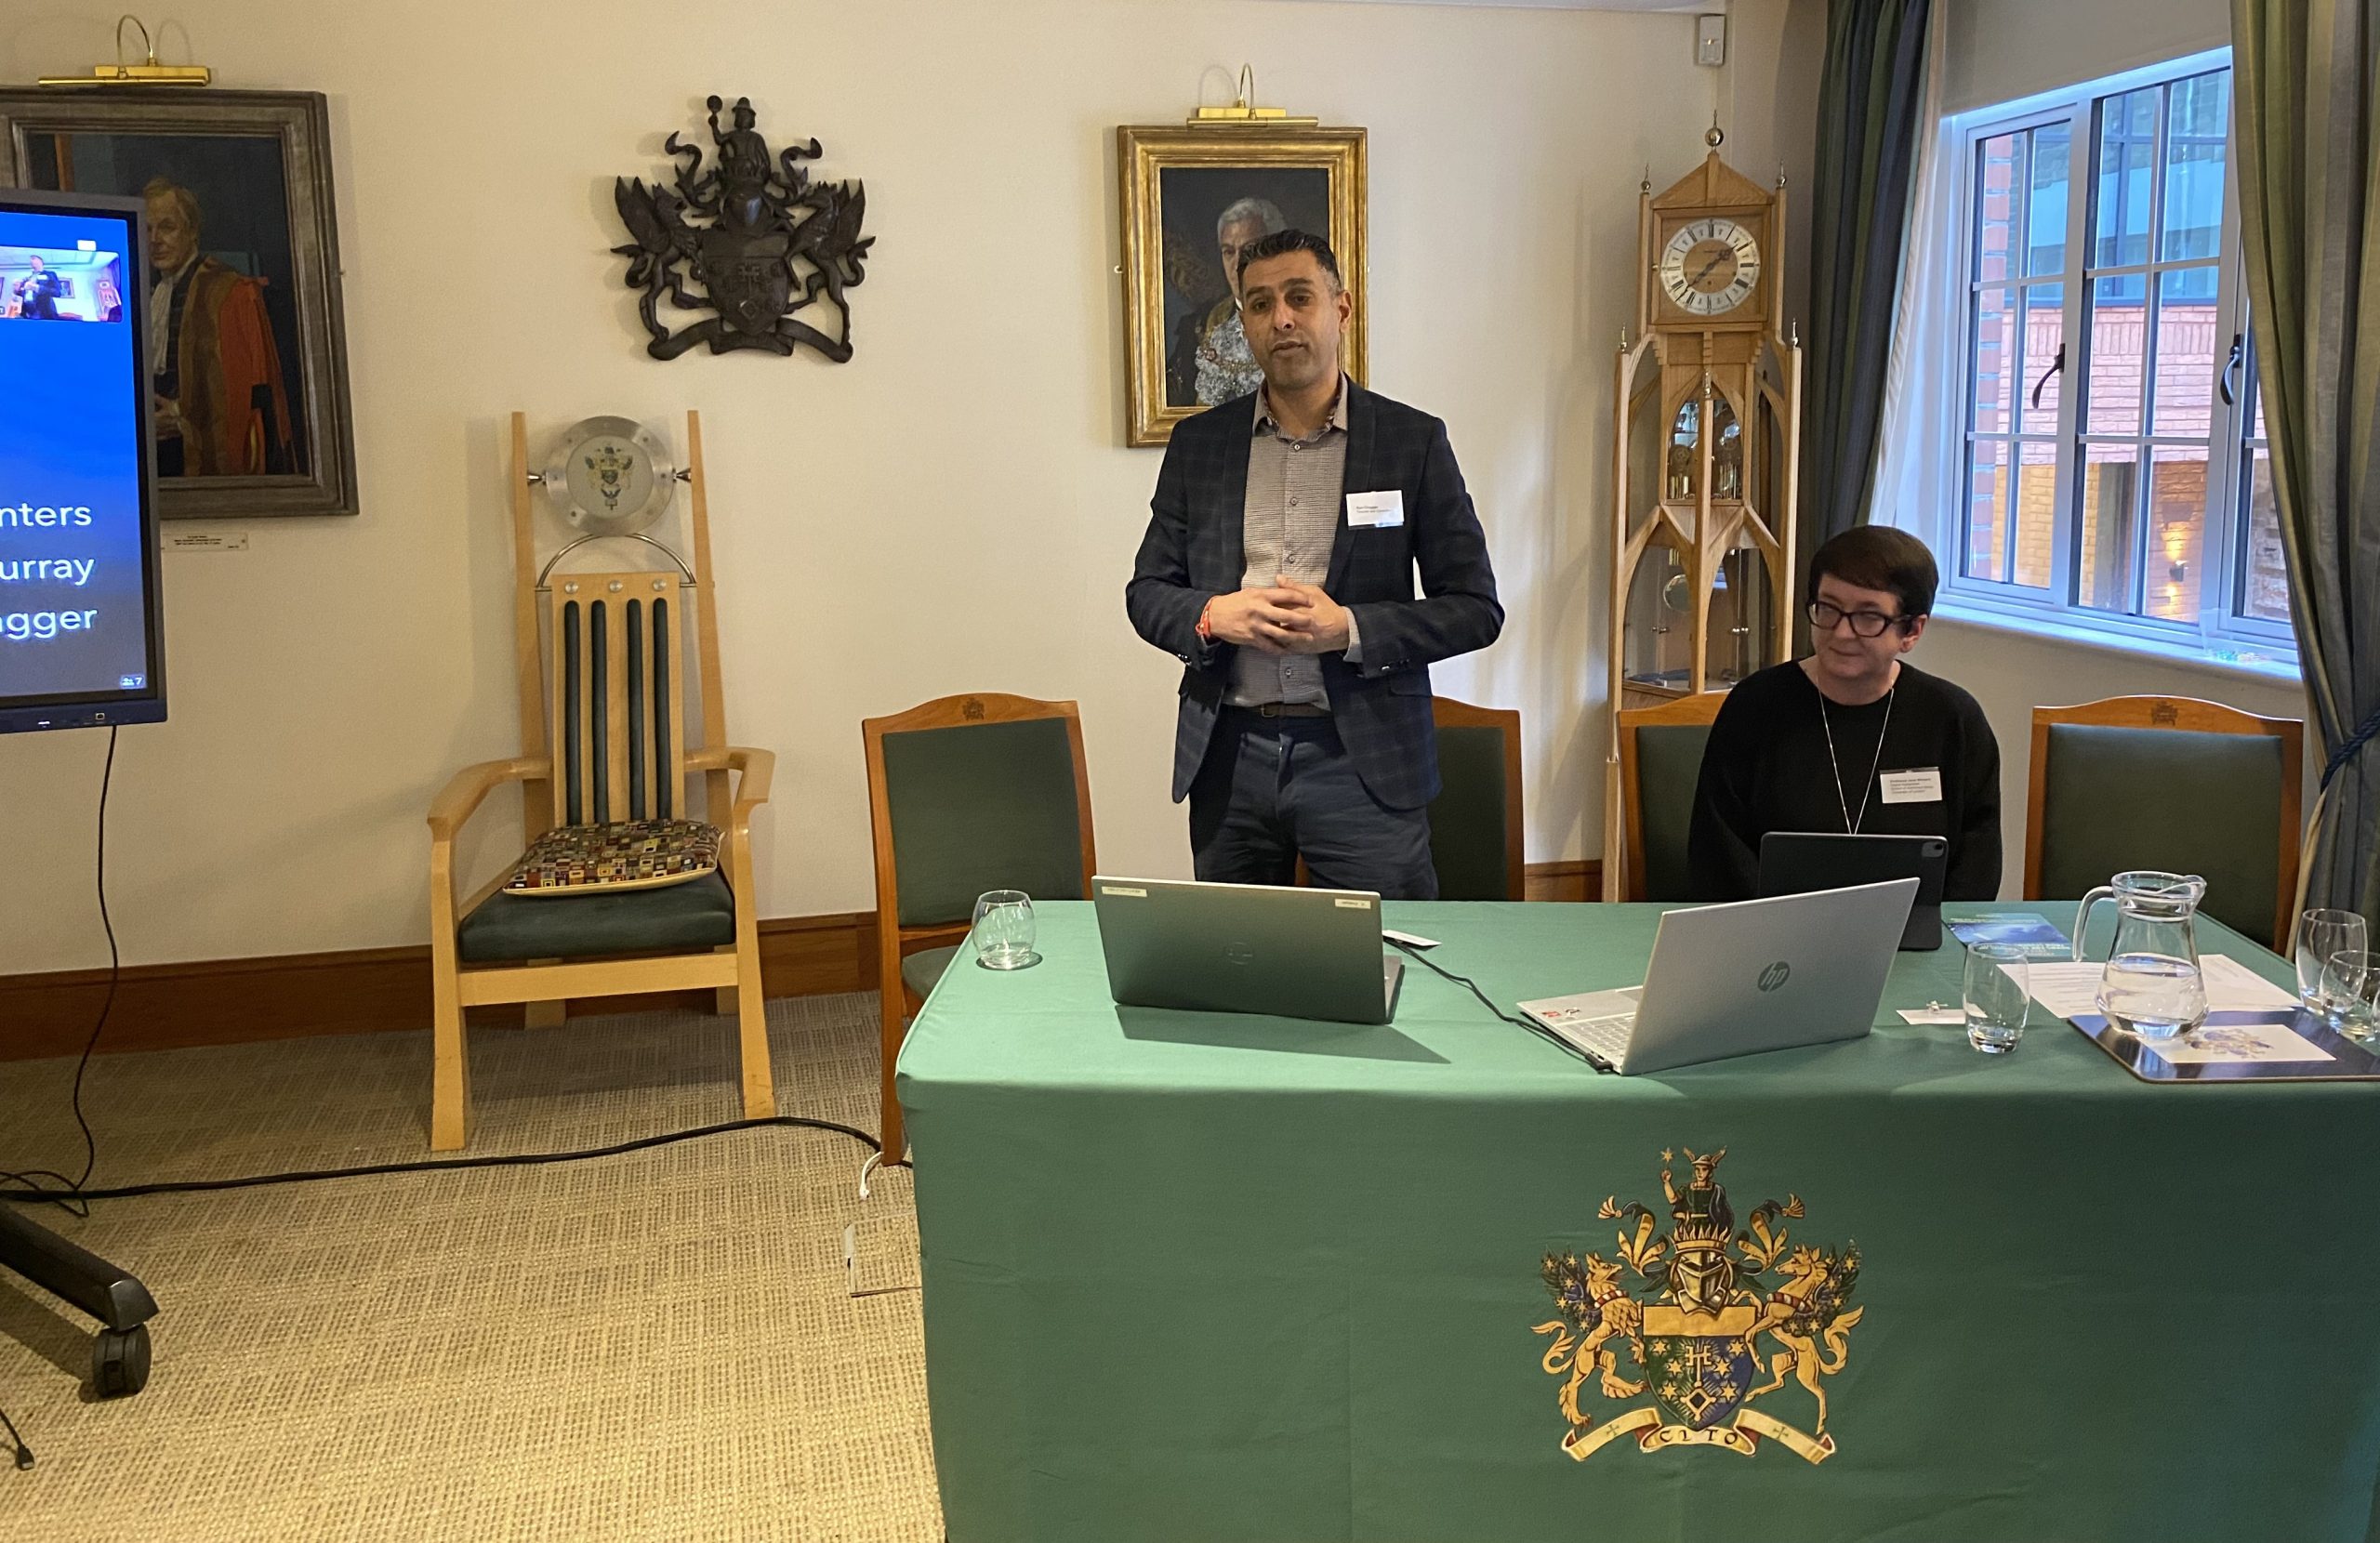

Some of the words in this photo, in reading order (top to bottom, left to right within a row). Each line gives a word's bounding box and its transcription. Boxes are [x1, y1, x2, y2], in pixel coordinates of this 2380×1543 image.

[0, 503, 92, 527] nters
[0, 559, 95, 586] urray
[0, 609, 98, 640] gger
[135, 677, 143, 686] 7
[1759, 962, 1789, 992] hp
